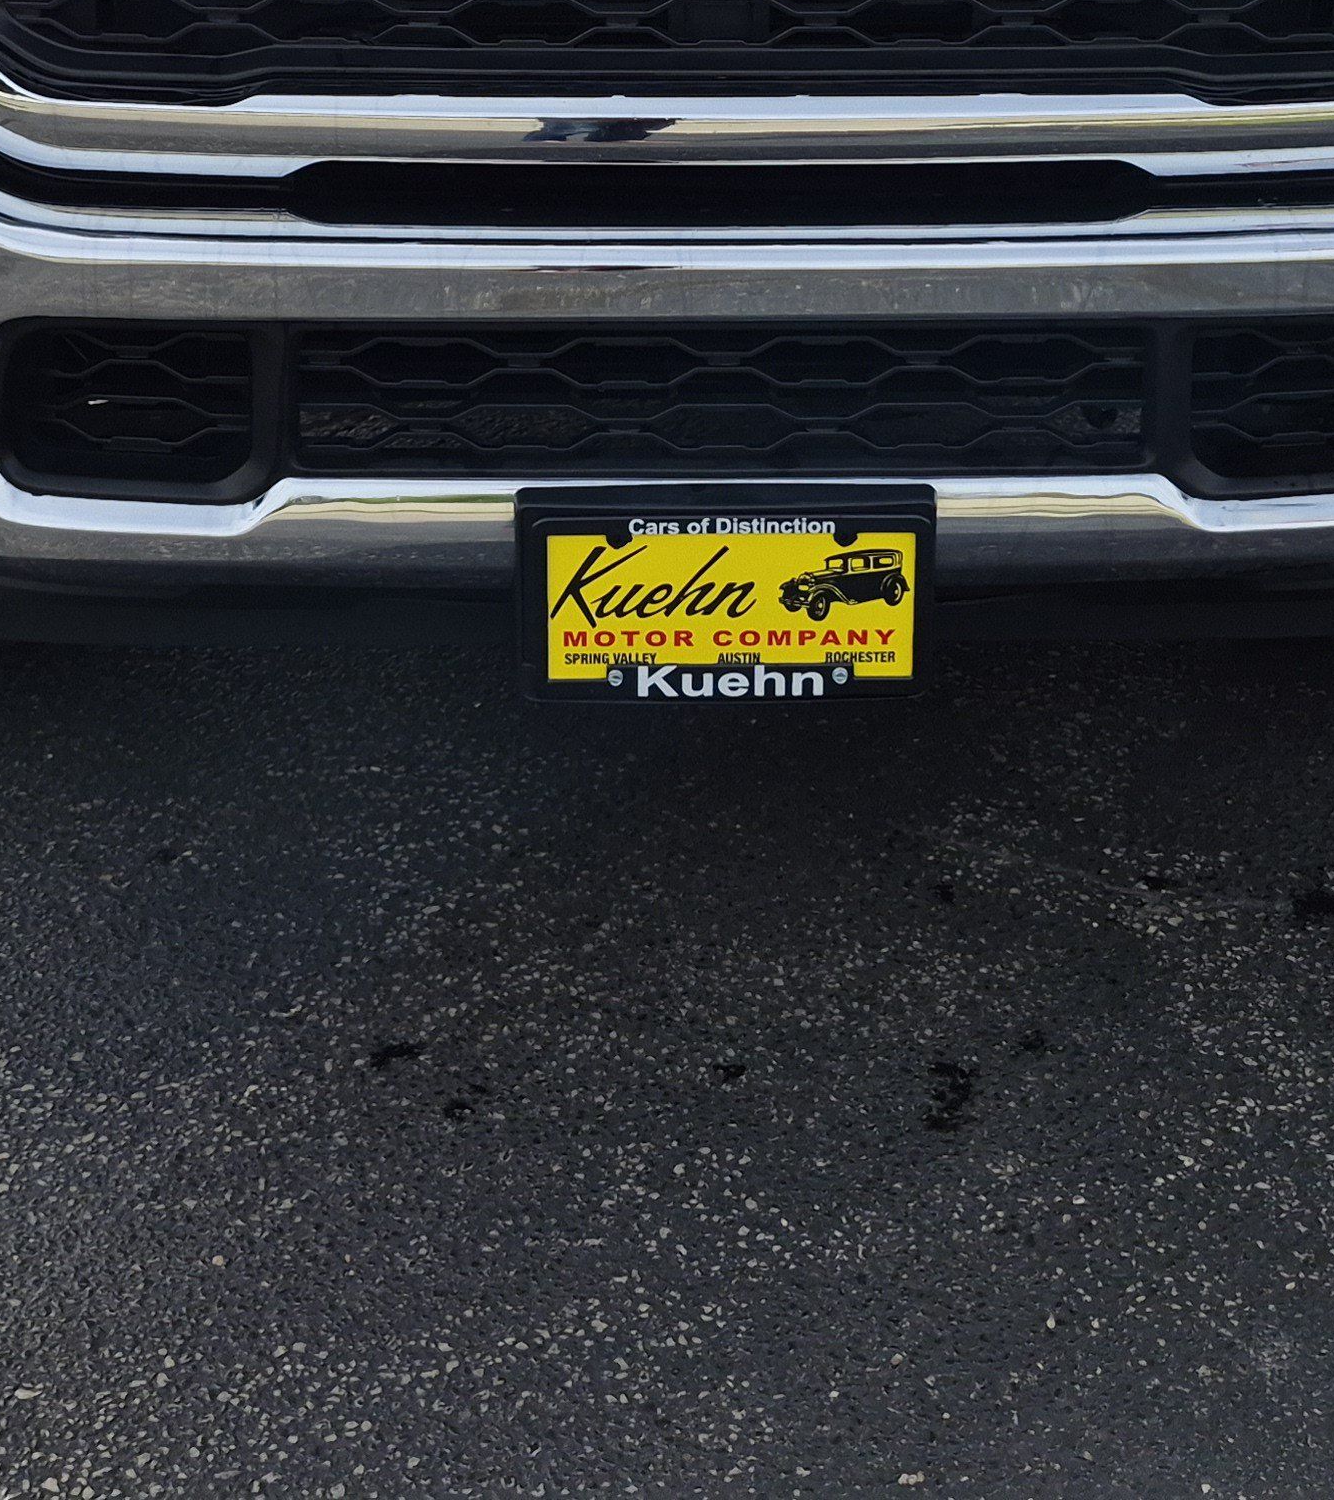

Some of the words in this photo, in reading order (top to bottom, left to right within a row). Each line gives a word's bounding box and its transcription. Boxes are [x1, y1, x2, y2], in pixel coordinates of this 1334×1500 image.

[628, 518, 680, 535] Cars
[686, 517, 710, 535] of
[716, 517, 836, 535] Distinction
[550, 545, 758, 627] Kuehn
[563, 630, 694, 647] MOTOR
[712, 629, 896, 646] COMPANY
[564, 652, 610, 665] SPRING
[613, 652, 658, 665] VALLEY
[717, 652, 761, 664] AUSTIN
[825, 650, 896, 664] ROCHESTER
[637, 665, 824, 697] Kuehn
